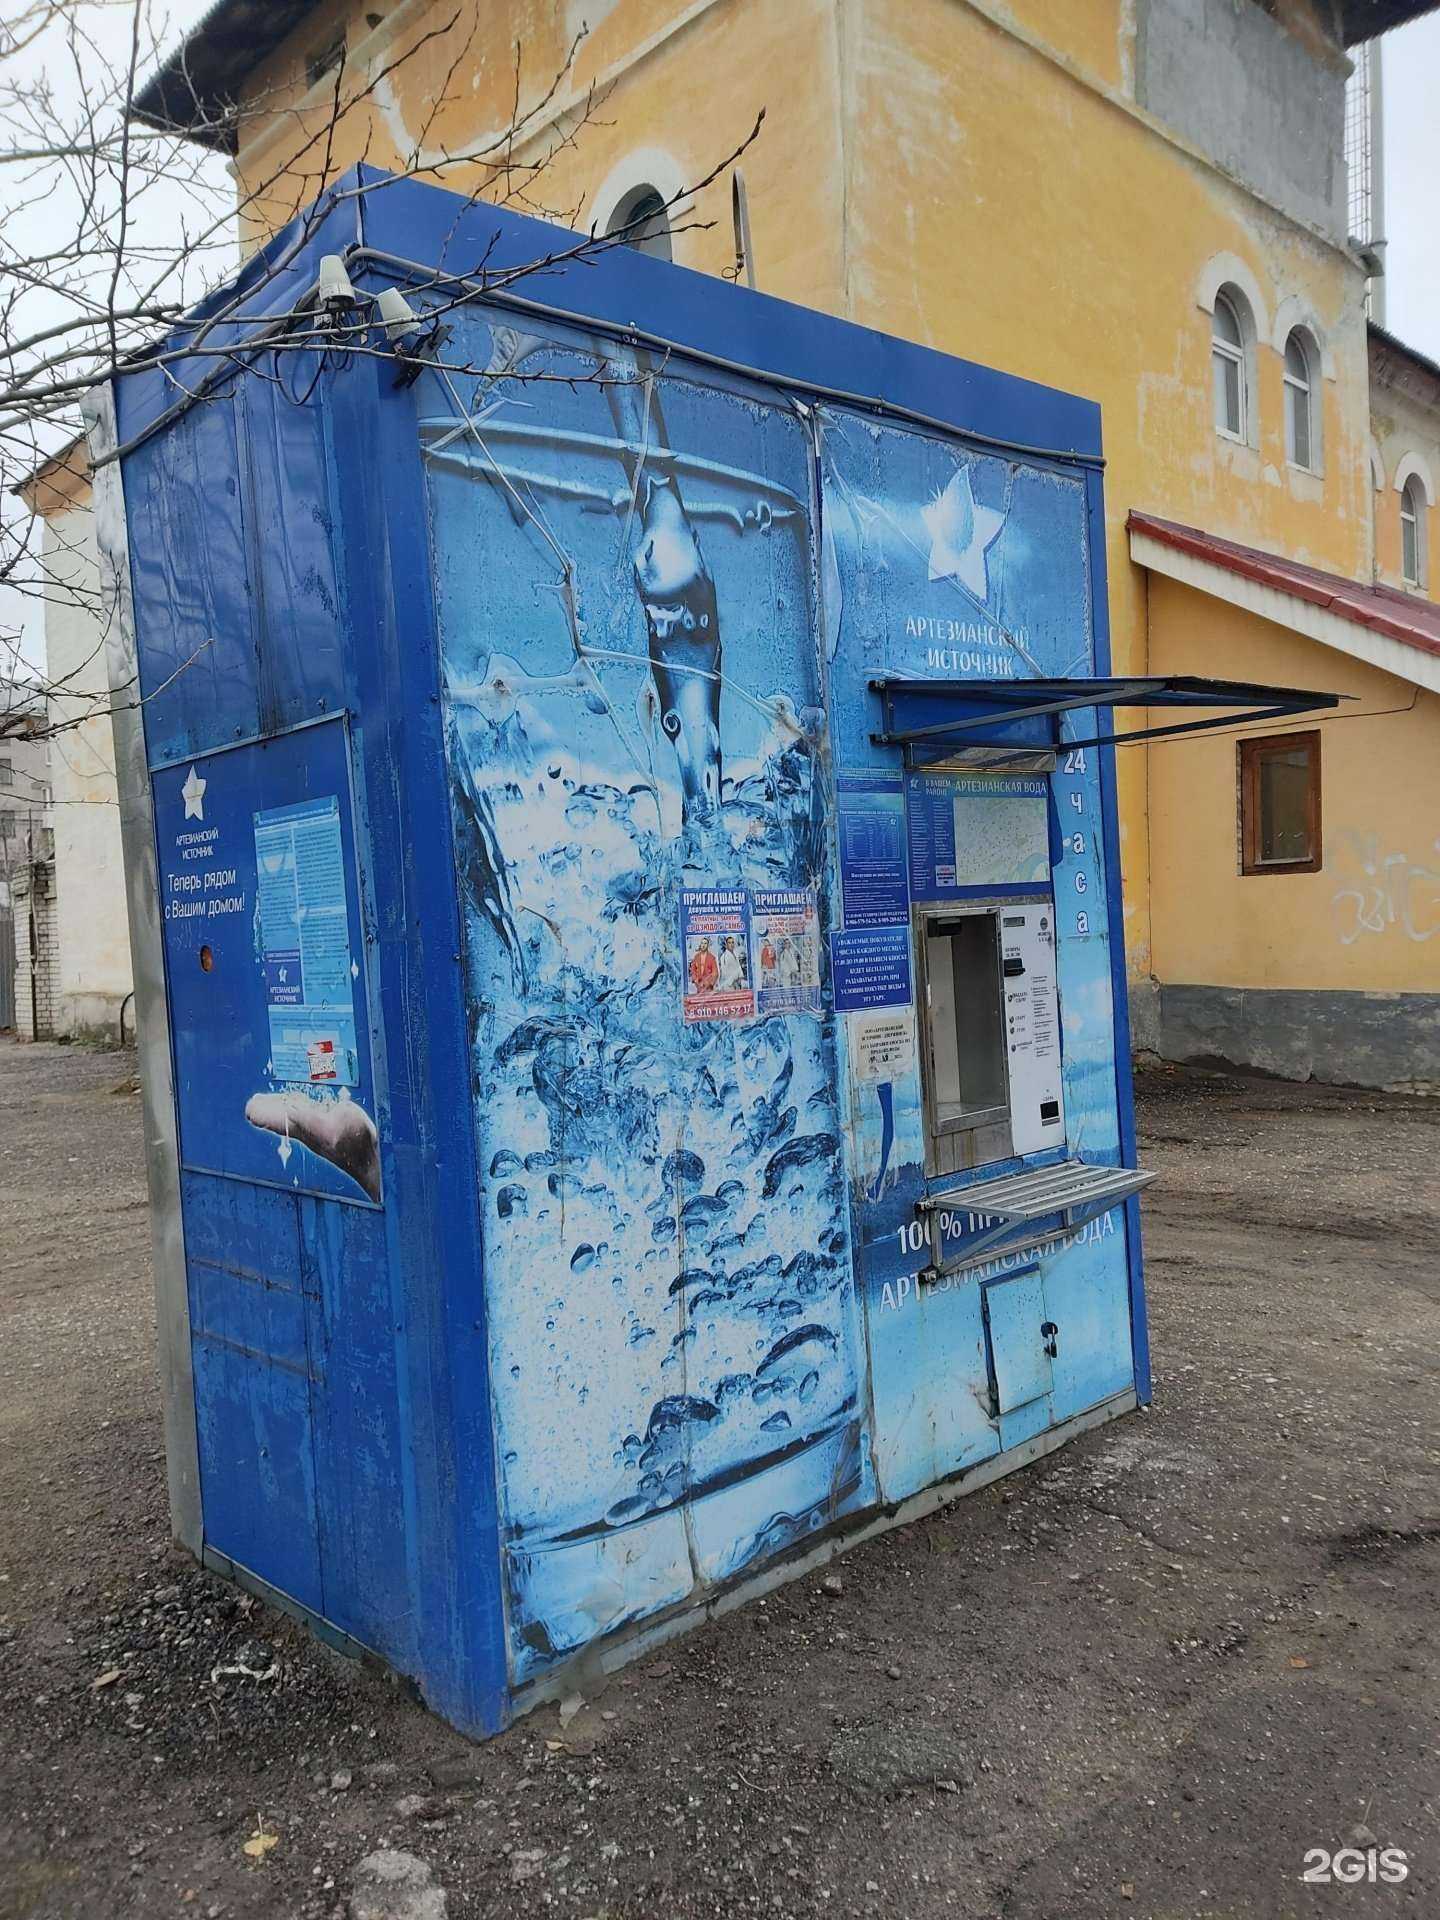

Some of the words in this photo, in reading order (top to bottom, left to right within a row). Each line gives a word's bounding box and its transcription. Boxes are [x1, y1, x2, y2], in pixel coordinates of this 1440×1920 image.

[906, 616, 1030, 650] АРТЕЗИАНСКИЙ
[928, 649, 1014, 675] ИСТОЧНИК
[1064, 748, 1086, 774] 24
[1025, 781, 1046, 796] ВОДА
[176, 827, 219, 846] АРТЕЗИАНСКИЙ
[182, 845, 214, 860] ИСТОЧНИК
[168, 872, 201, 894] Теперь
[204, 869, 236, 893] рядом
[165, 905, 170, 919] с
[172, 900, 206, 919] Вашим
[208, 892, 245, 918] домом!
[684, 892, 745, 905] ПРИГЛАШАЕМ
